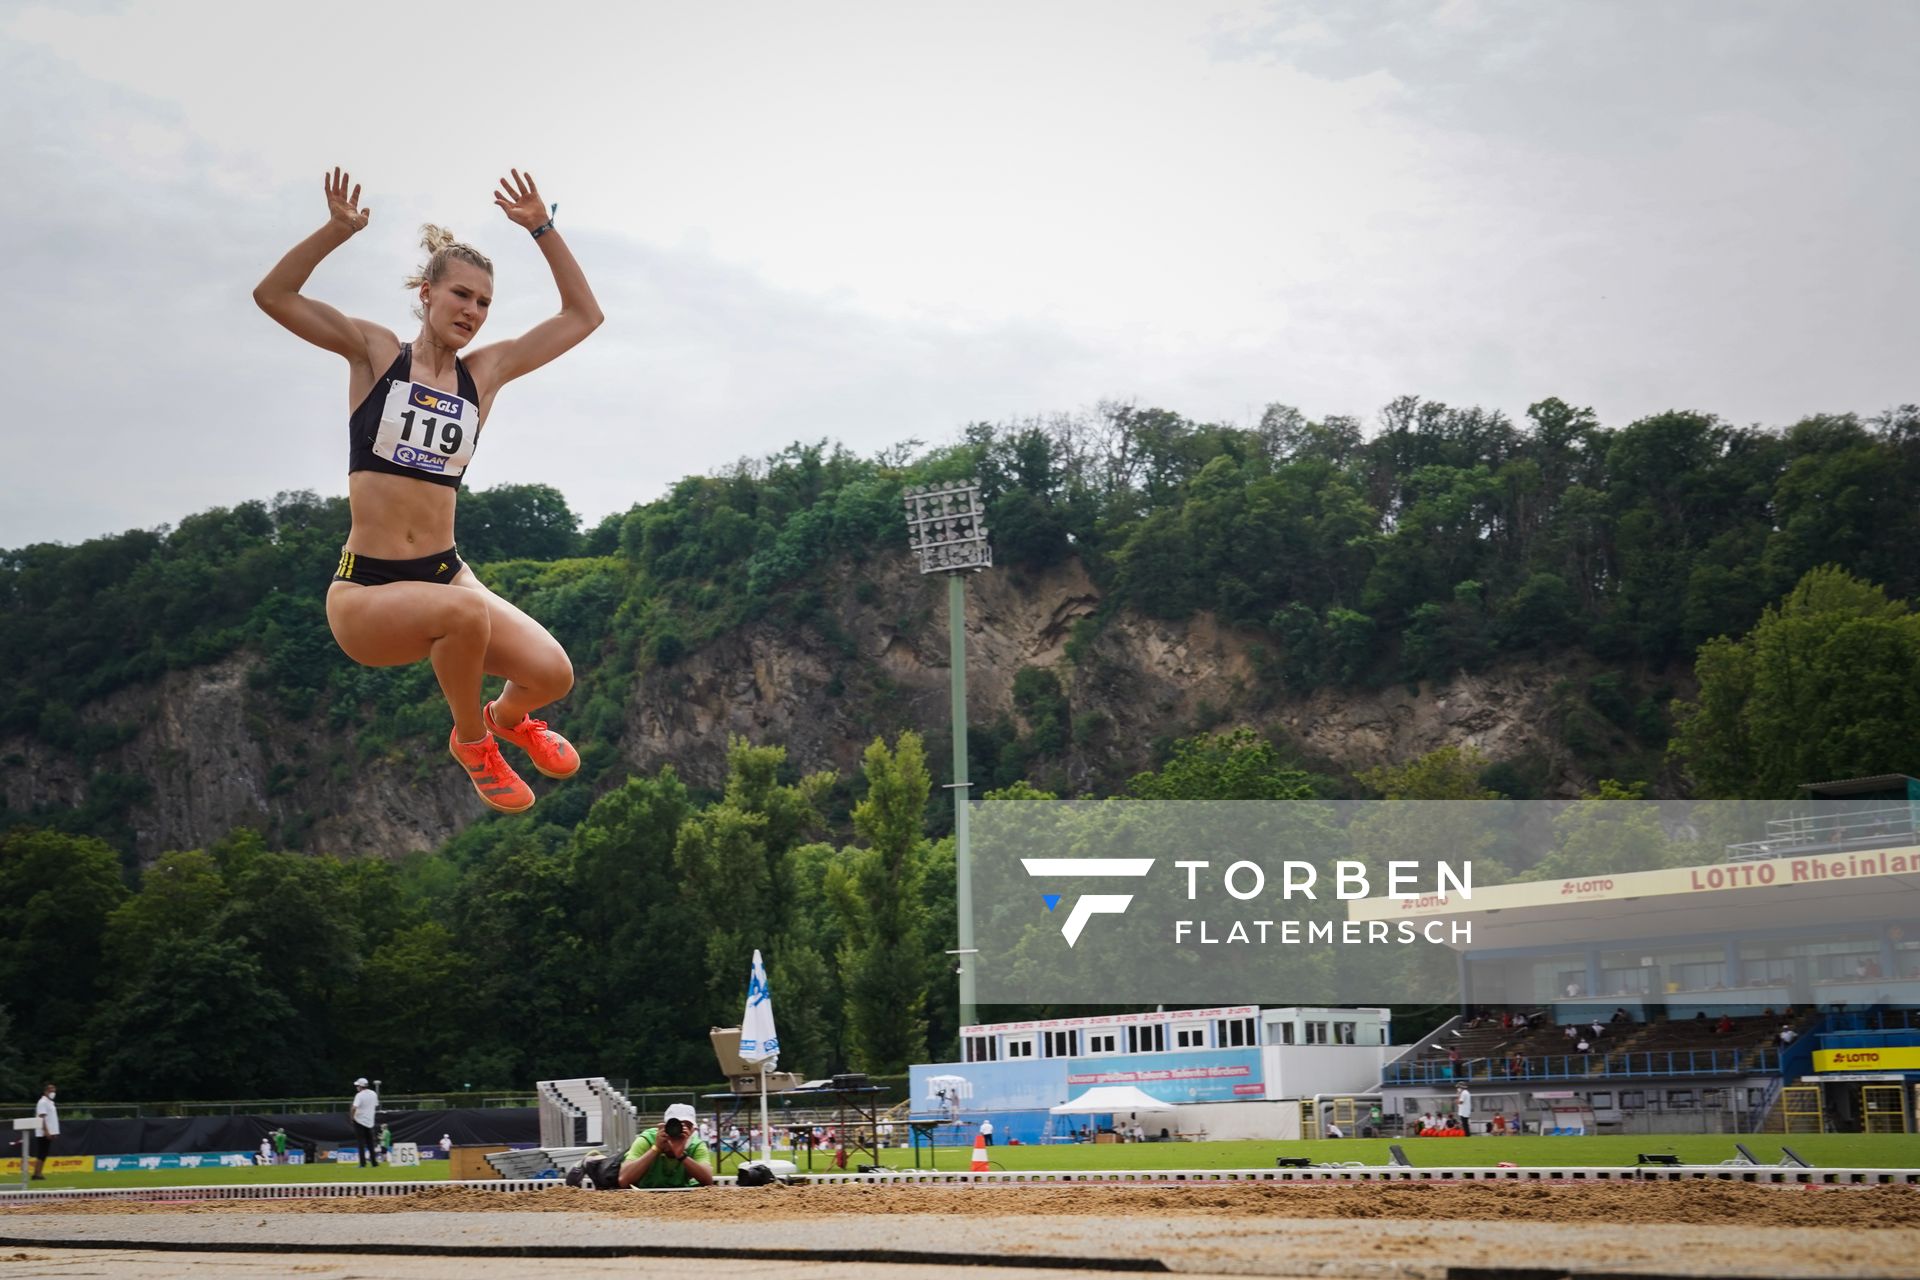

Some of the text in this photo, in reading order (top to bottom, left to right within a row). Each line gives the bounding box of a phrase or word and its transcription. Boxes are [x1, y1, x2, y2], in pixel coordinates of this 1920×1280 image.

[436, 400, 459, 414] GLS
[400, 409, 463, 455] 119
[417, 453, 445, 465] PLAN
[1691, 863, 1775, 890] LOTTO
[1577, 879, 1613, 893] LOTTO
[1846, 1052, 1879, 1062] LOTTO
[401, 1147, 415, 1163] 65
